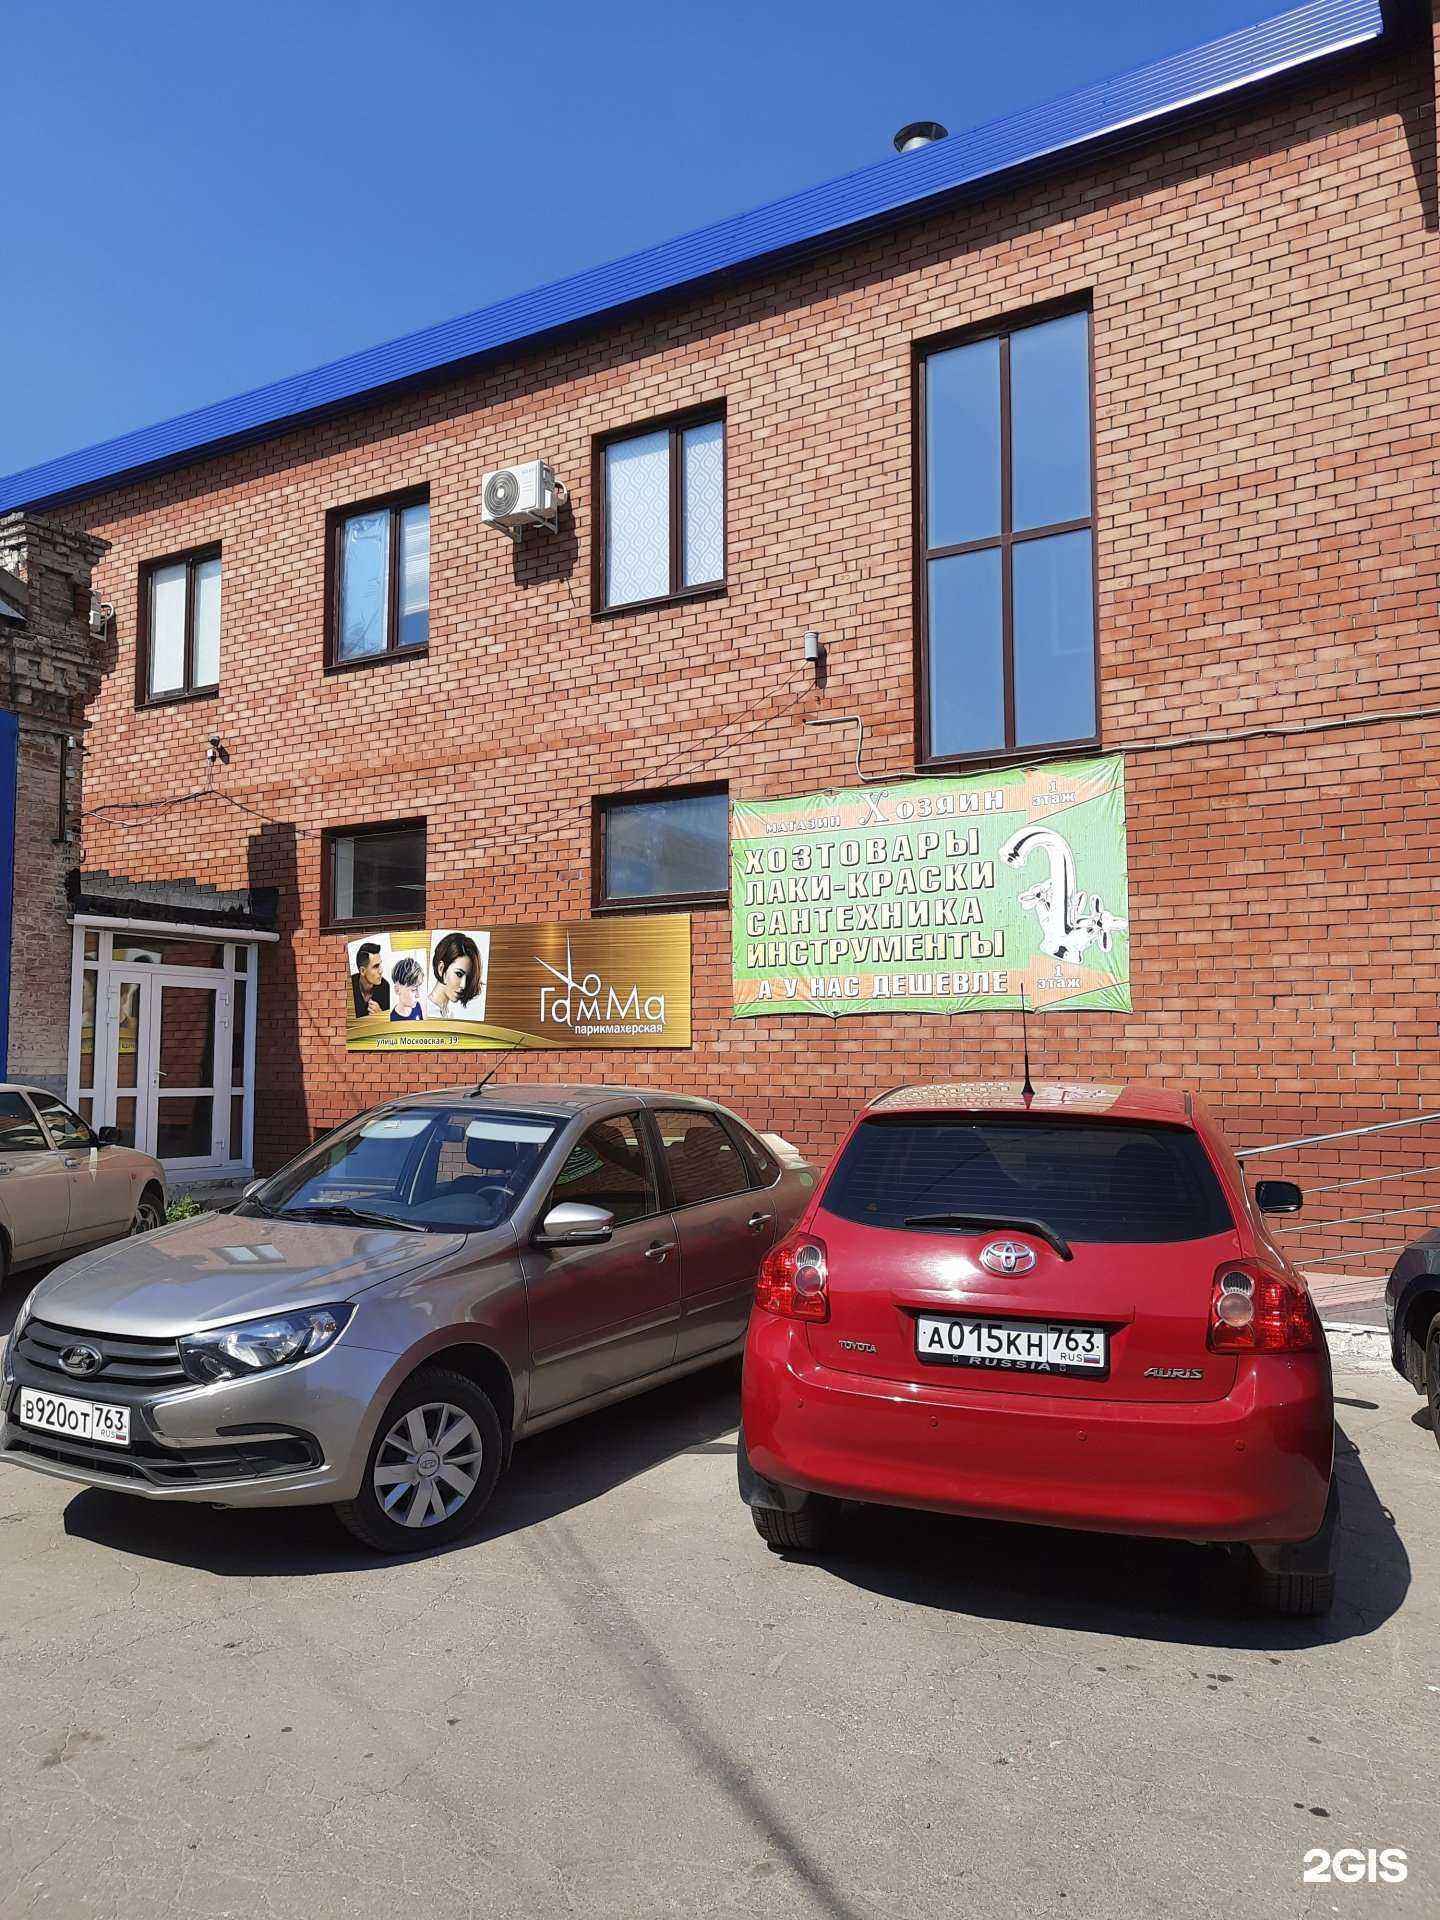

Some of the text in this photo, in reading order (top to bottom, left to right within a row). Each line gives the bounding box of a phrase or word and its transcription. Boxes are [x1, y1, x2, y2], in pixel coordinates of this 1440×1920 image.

[1048, 780, 1058, 792] 1
[744, 827, 980, 875] ХОЗТОВАРЫ
[744, 861, 995, 906] ЛАКИ-КРАСКИ
[746, 896, 984, 937] САНТЕХНИКА
[746, 929, 1005, 969] ИНСТРУМЕНТЫ
[1053, 965, 1063, 977] 1
[757, 970, 1009, 1000] А У НАС ДЕШЕВЛЕ
[574, 1023, 664, 1037] парикмахерская
[376, 1037, 398, 1047] улица
[448, 1036, 459, 1045] 39
[838, 1340, 878, 1353] TOYOTA
[1050, 1327, 1095, 1353] 763
[969, 1356, 1051, 1371] RUSSIA
[1060, 1352, 1083, 1362] RUS
[95, 1407, 124, 1431] 763
[100, 1429, 116, 1439] RUS
